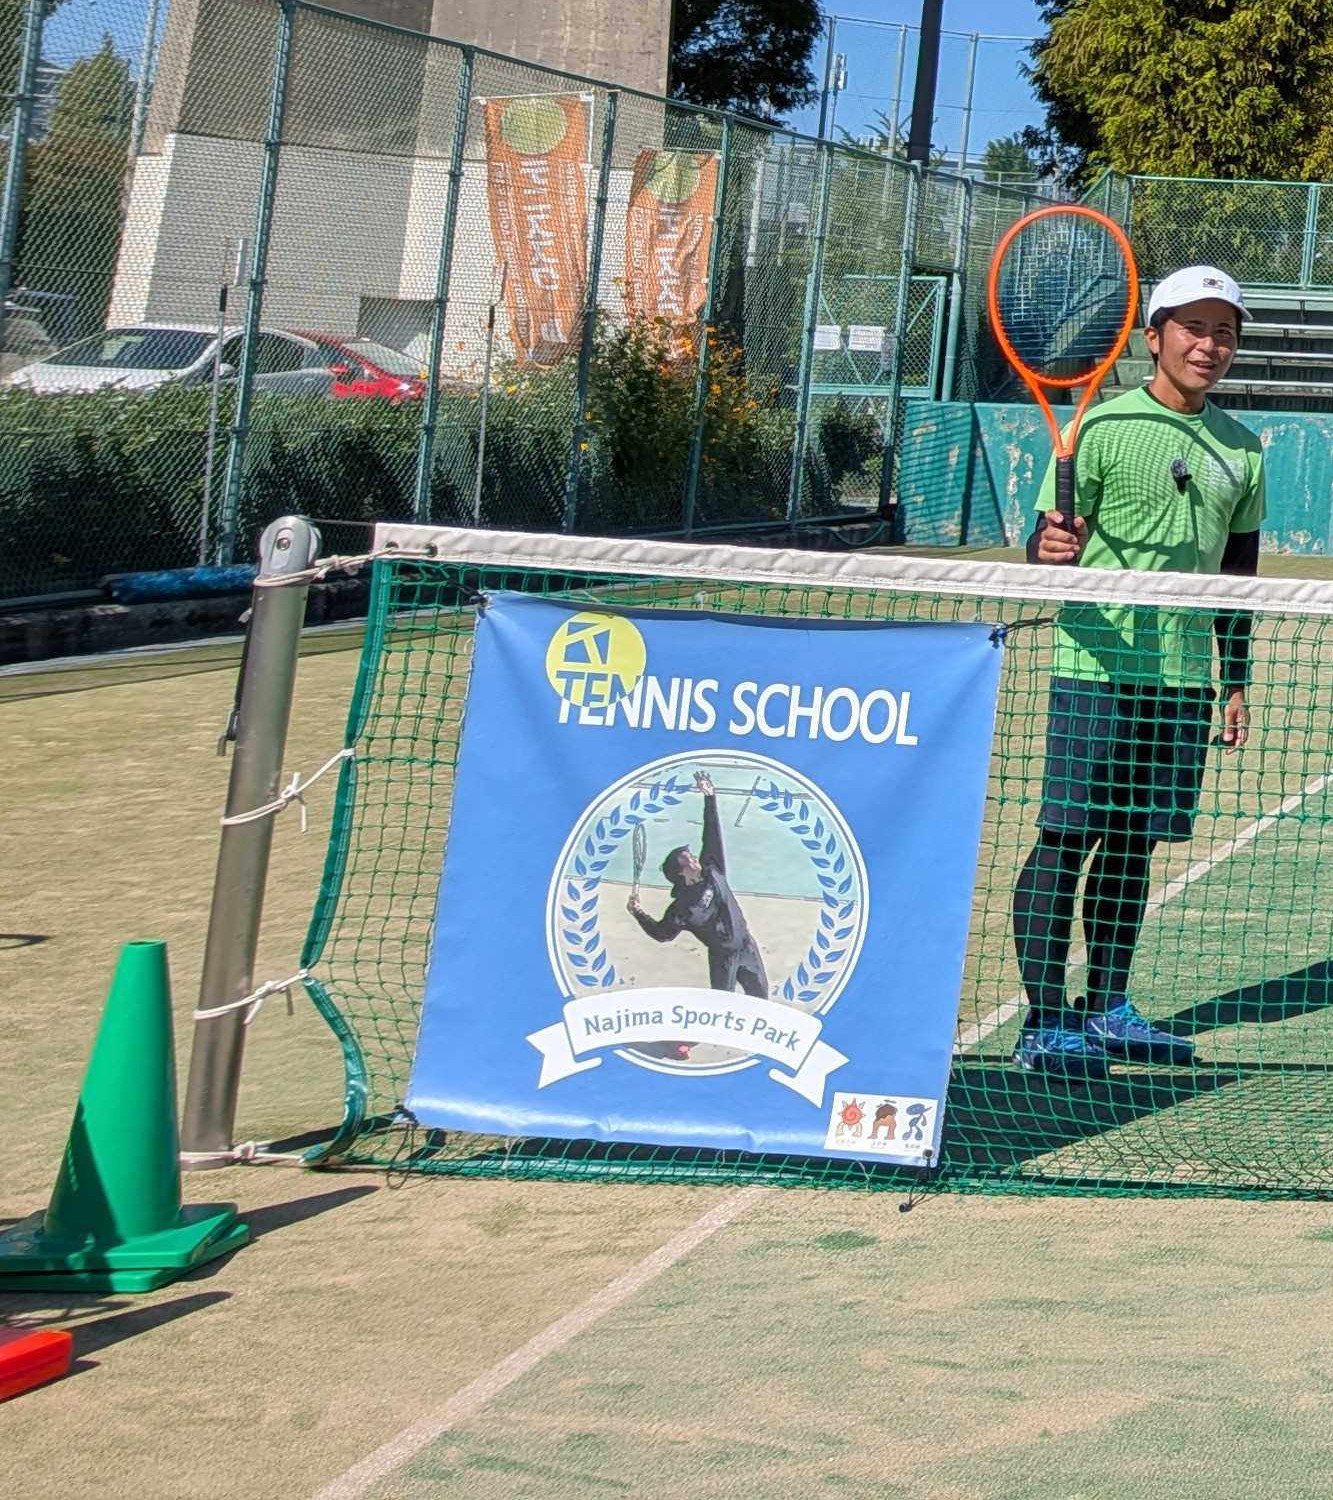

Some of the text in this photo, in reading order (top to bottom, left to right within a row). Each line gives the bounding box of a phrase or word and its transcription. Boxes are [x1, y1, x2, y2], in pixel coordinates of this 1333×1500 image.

[556, 670, 919, 746] TENNIS SCHOOL
[583, 1005, 802, 1051] Najima Sports Park
